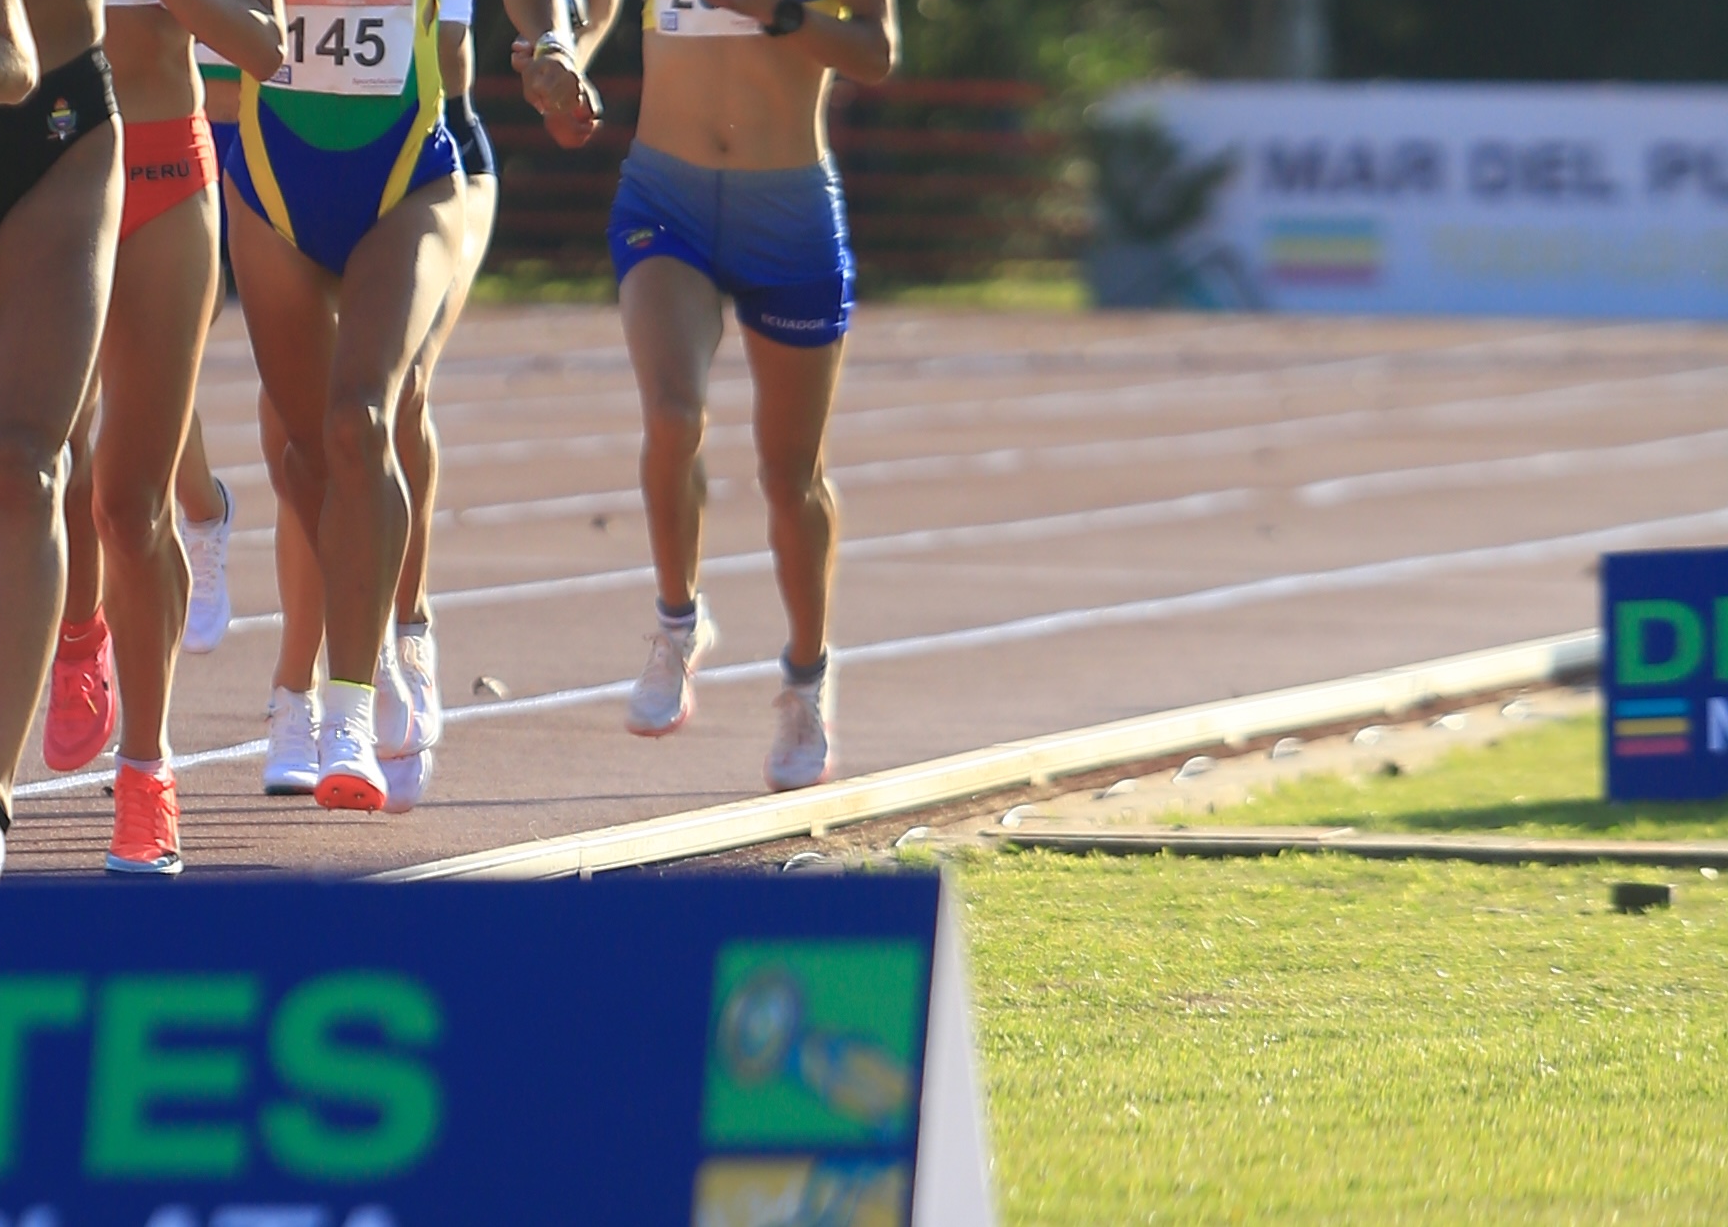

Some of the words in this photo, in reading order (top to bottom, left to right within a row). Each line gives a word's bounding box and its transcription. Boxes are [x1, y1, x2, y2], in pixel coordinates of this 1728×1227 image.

[287, 16, 386, 67] 145
[1260, 137, 1443, 195] MAR
[1467, 139, 1618, 201] DEL
[761, 313, 825, 330] ECUADOR
[1614, 596, 1728, 686] D
